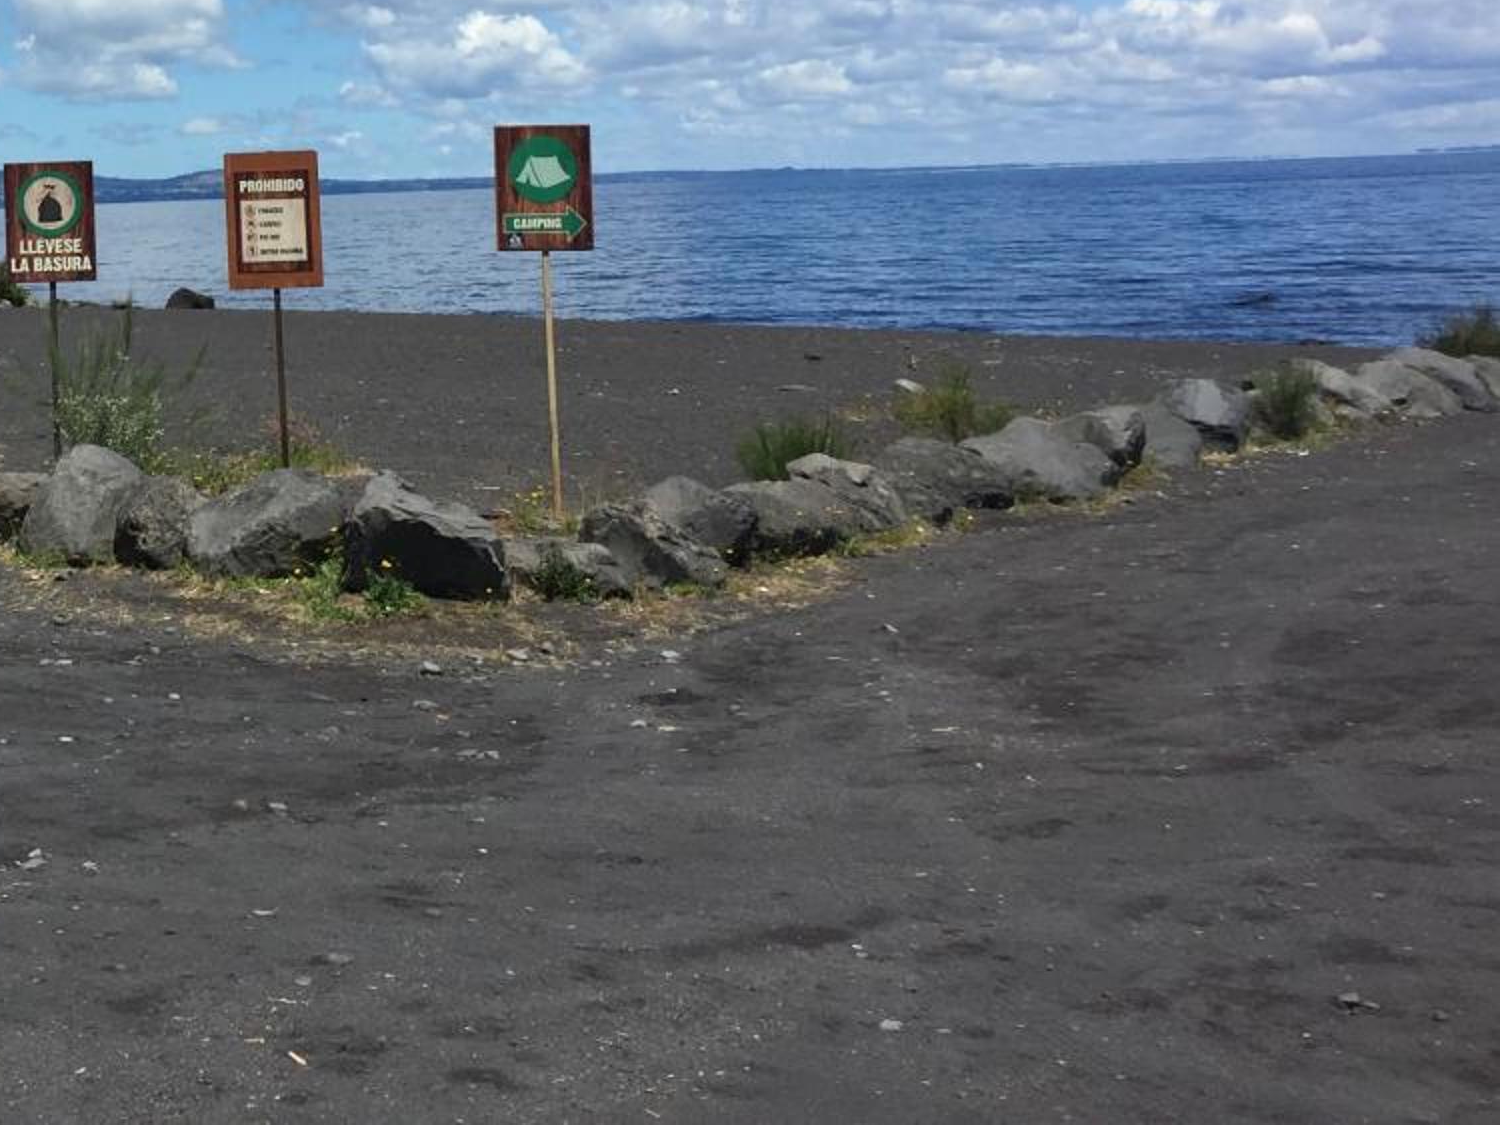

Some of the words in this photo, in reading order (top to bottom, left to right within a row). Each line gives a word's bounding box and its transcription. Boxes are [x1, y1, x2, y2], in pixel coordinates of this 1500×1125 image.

[239, 178, 304, 193] PROHIBIDO
[513, 218, 562, 229] CAMPING
[19, 238, 82, 254] LLEVESE
[11, 258, 29, 273] LA
[34, 255, 92, 272] BASURA
